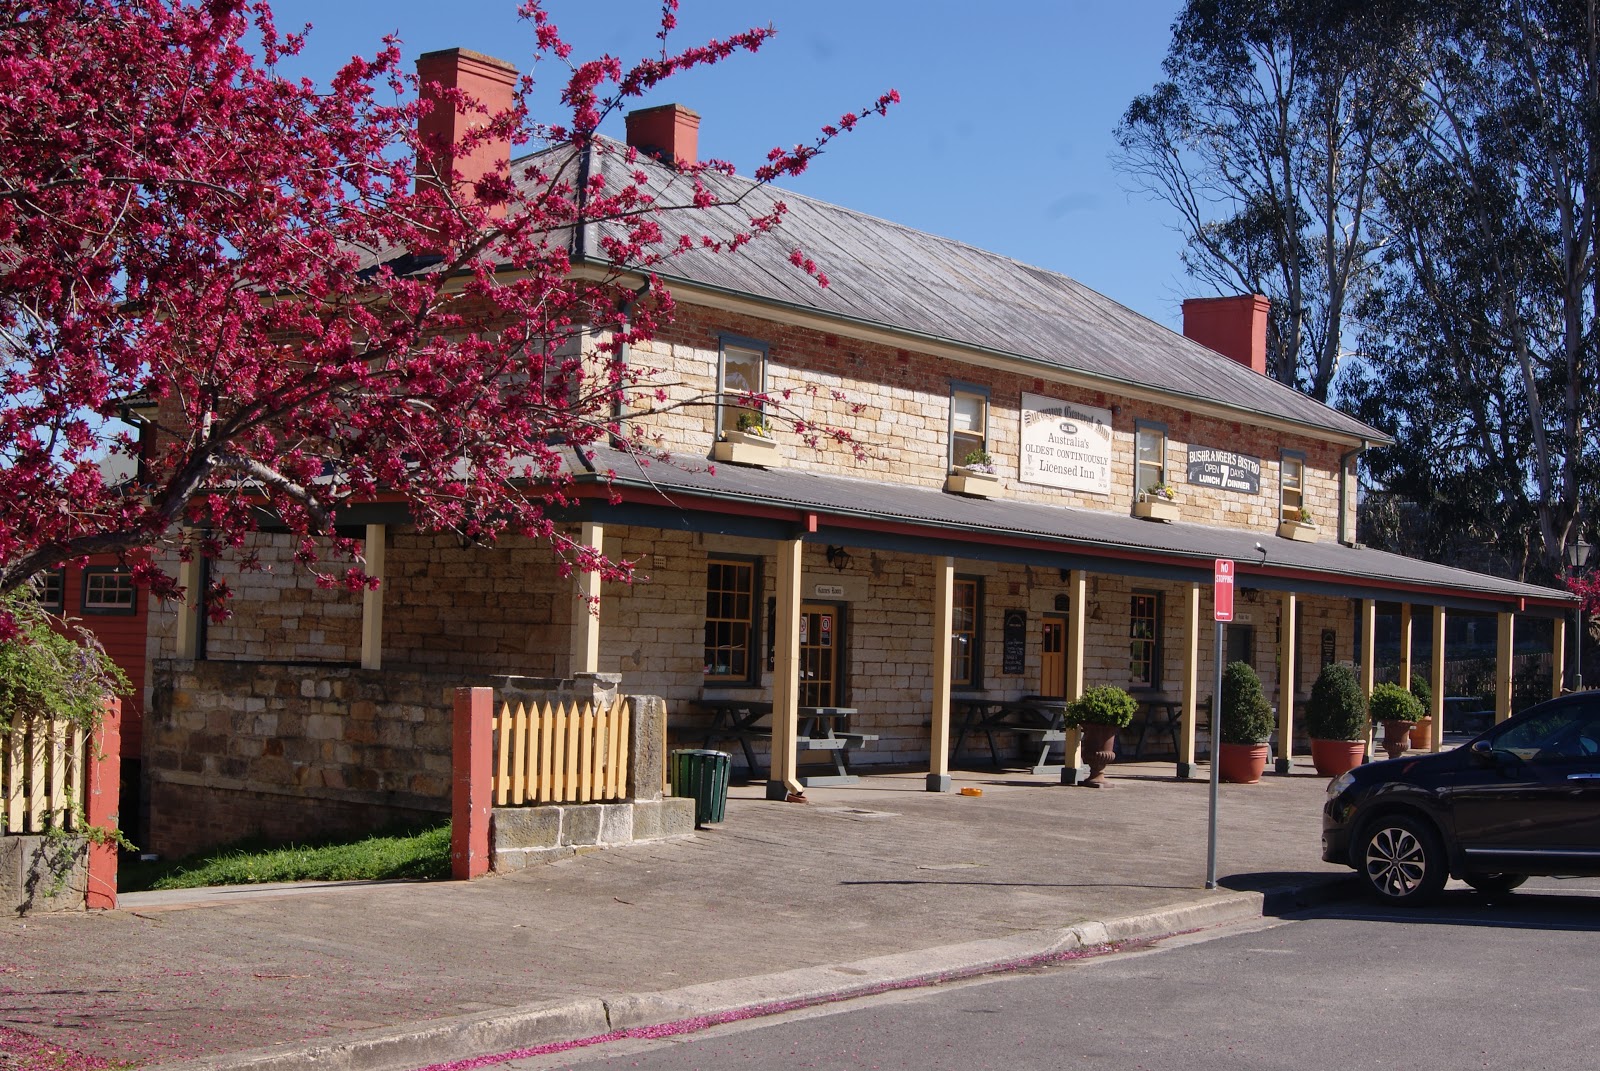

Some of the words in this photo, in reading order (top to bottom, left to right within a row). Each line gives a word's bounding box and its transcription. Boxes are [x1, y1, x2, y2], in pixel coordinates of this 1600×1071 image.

[1064, 405, 1094, 427] General
[1095, 418, 1110, 442] Inn
[1048, 432, 1090, 449] Australia's
[1025, 444, 1054, 456] OLDEST
[1056, 449, 1109, 466] CONTINUOUSLY
[1189, 450, 1236, 465] BUSHRANGERS
[1238, 456, 1260, 475] BISTRO
[1039, 460, 1078, 476] Licensed
[1079, 466, 1095, 480] Inn
[1204, 464, 1220, 474] OPEN
[1220, 464, 1230, 487] 7
[1230, 468, 1244, 478] DAYS
[1199, 474, 1220, 485] LUNCH
[1227, 479, 1250, 490] DINNER
[1220, 564, 1228, 573] NO
[1216, 575, 1233, 583] STOPPING
